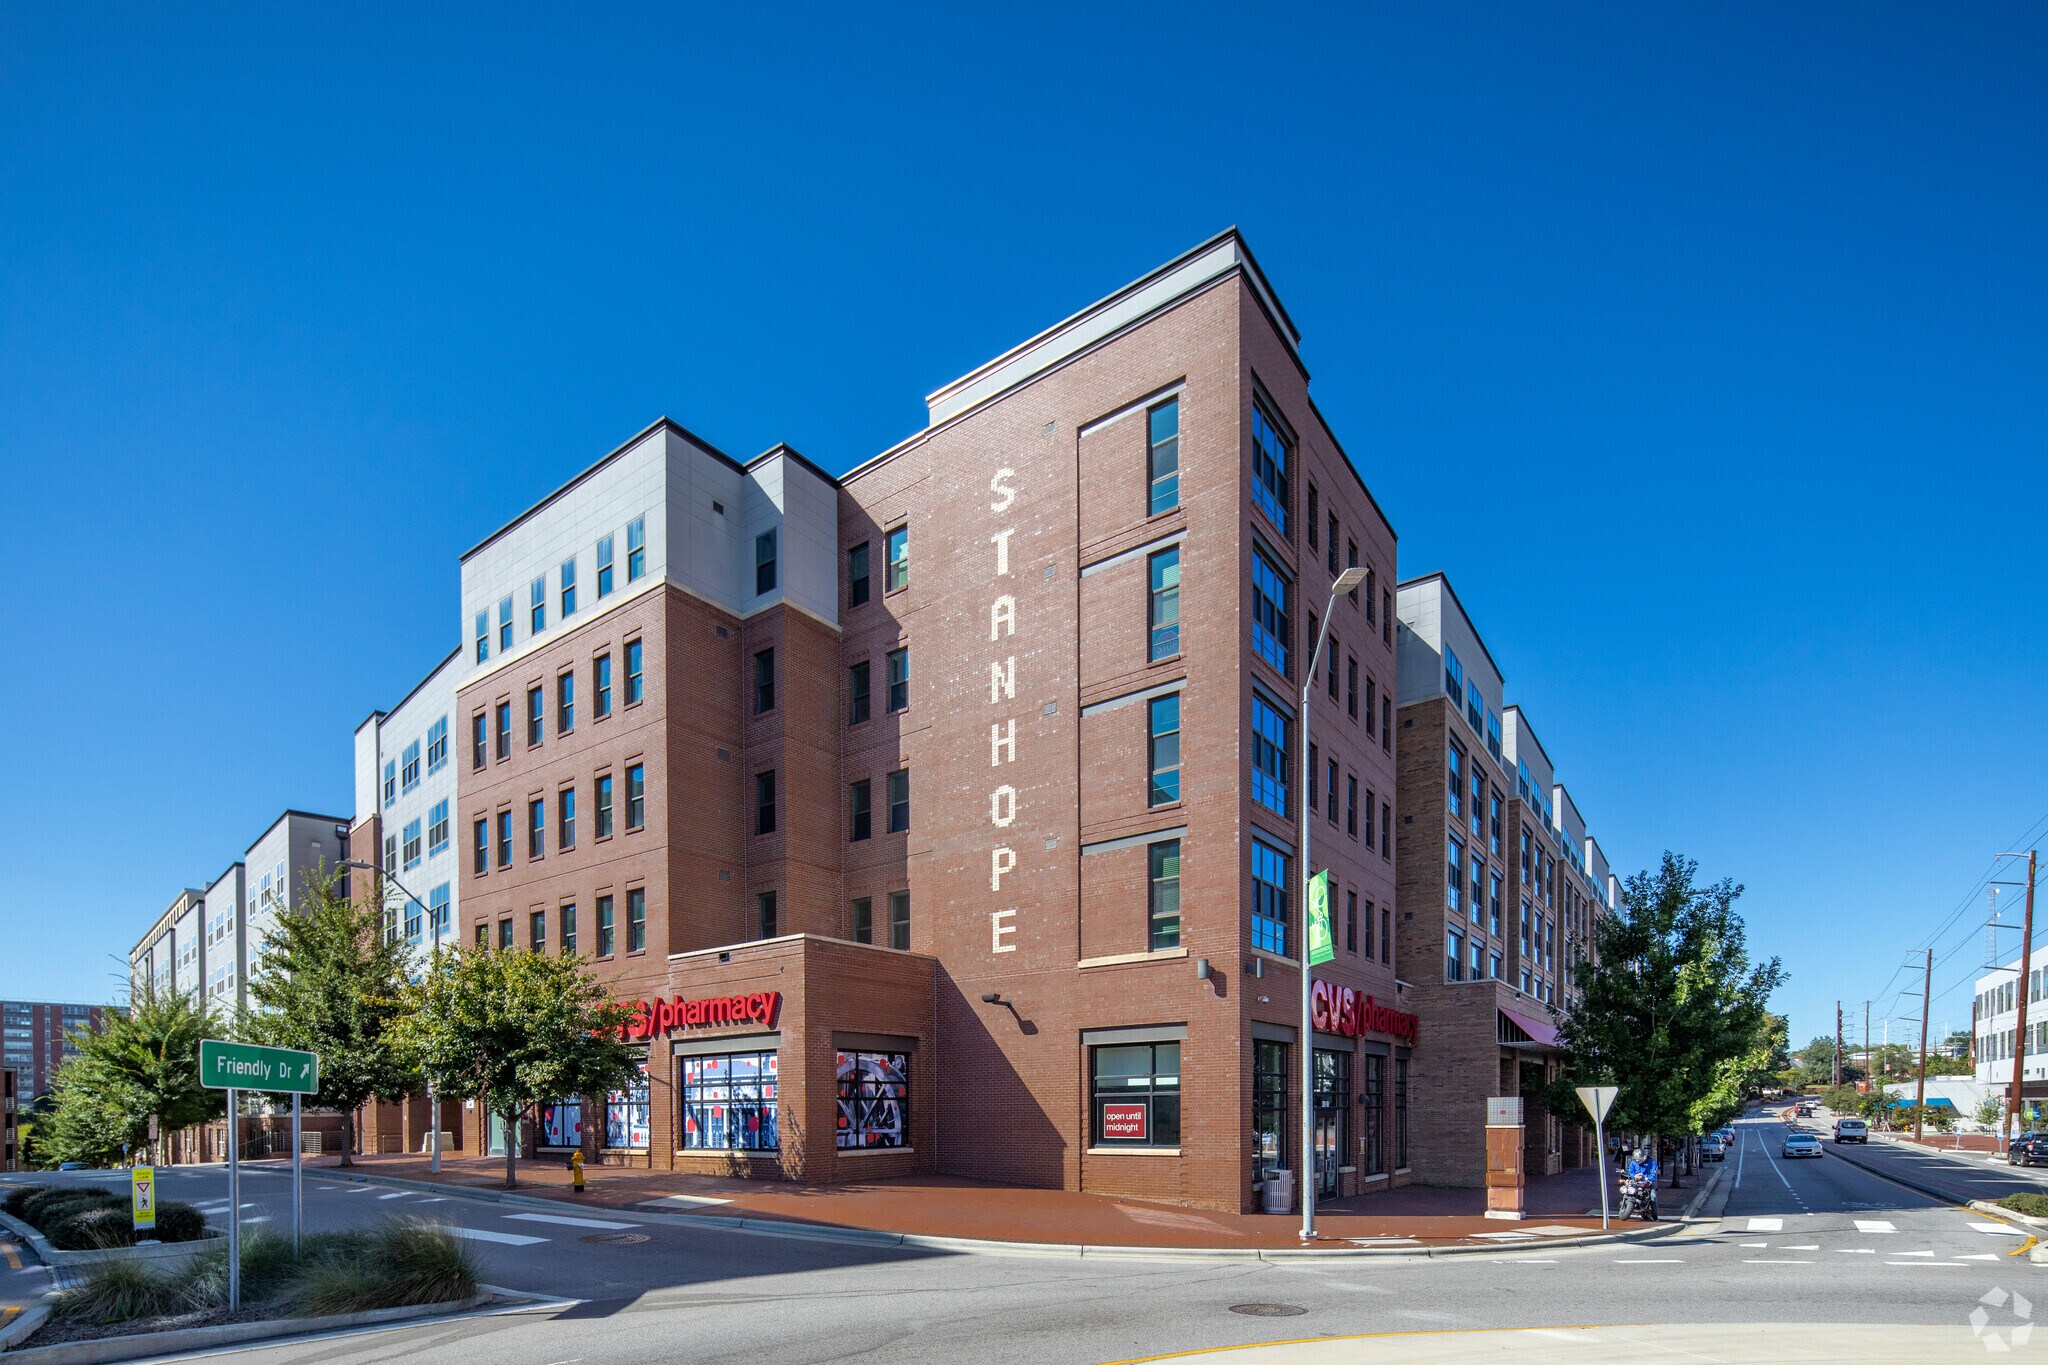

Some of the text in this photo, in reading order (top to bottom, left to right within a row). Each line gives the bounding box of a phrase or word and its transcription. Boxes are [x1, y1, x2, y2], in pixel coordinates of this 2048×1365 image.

[990, 467, 1016, 953] STANHOPE
[217, 1055, 292, 1080] Friendly Dr
[1106, 1112, 1142, 1121] open until
[1106, 1123, 1139, 1133] midnight
